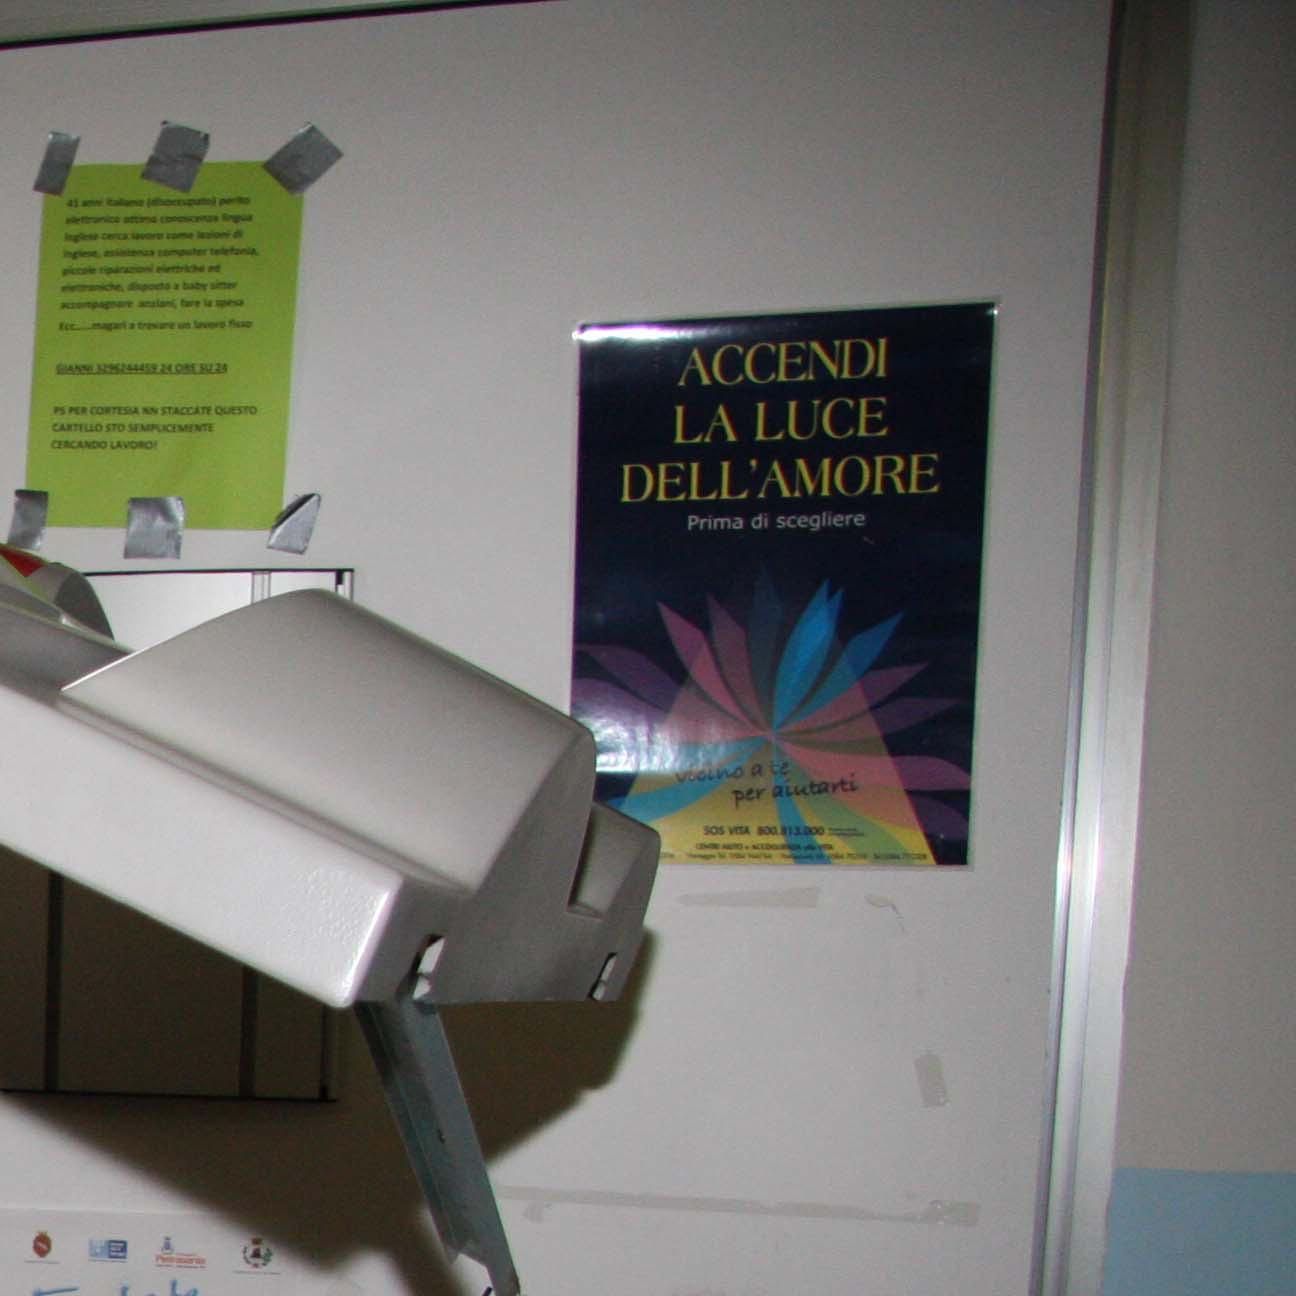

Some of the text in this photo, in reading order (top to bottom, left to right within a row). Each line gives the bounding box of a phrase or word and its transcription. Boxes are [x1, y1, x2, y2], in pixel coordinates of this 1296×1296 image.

[677, 338, 887, 387] ACCENDI
[68, 407, 87, 415] PER
[90, 406, 139, 415] CORTESIA
[161, 406, 212, 415] STACCATE
[215, 405, 257, 416] QUESTO
[52, 423, 214, 433] CARTELLO STO SEMPLICEMENTE
[674, 397, 888, 444] LA LUCE
[51, 441, 107, 449] CERCANDO
[621, 454, 941, 502] DELL'AMORE
[687, 512, 866, 531] Prima di scegliere
[732, 773, 858, 809] per aiutarti
[704, 826, 725, 836] SOS
[729, 826, 750, 835] VITA
